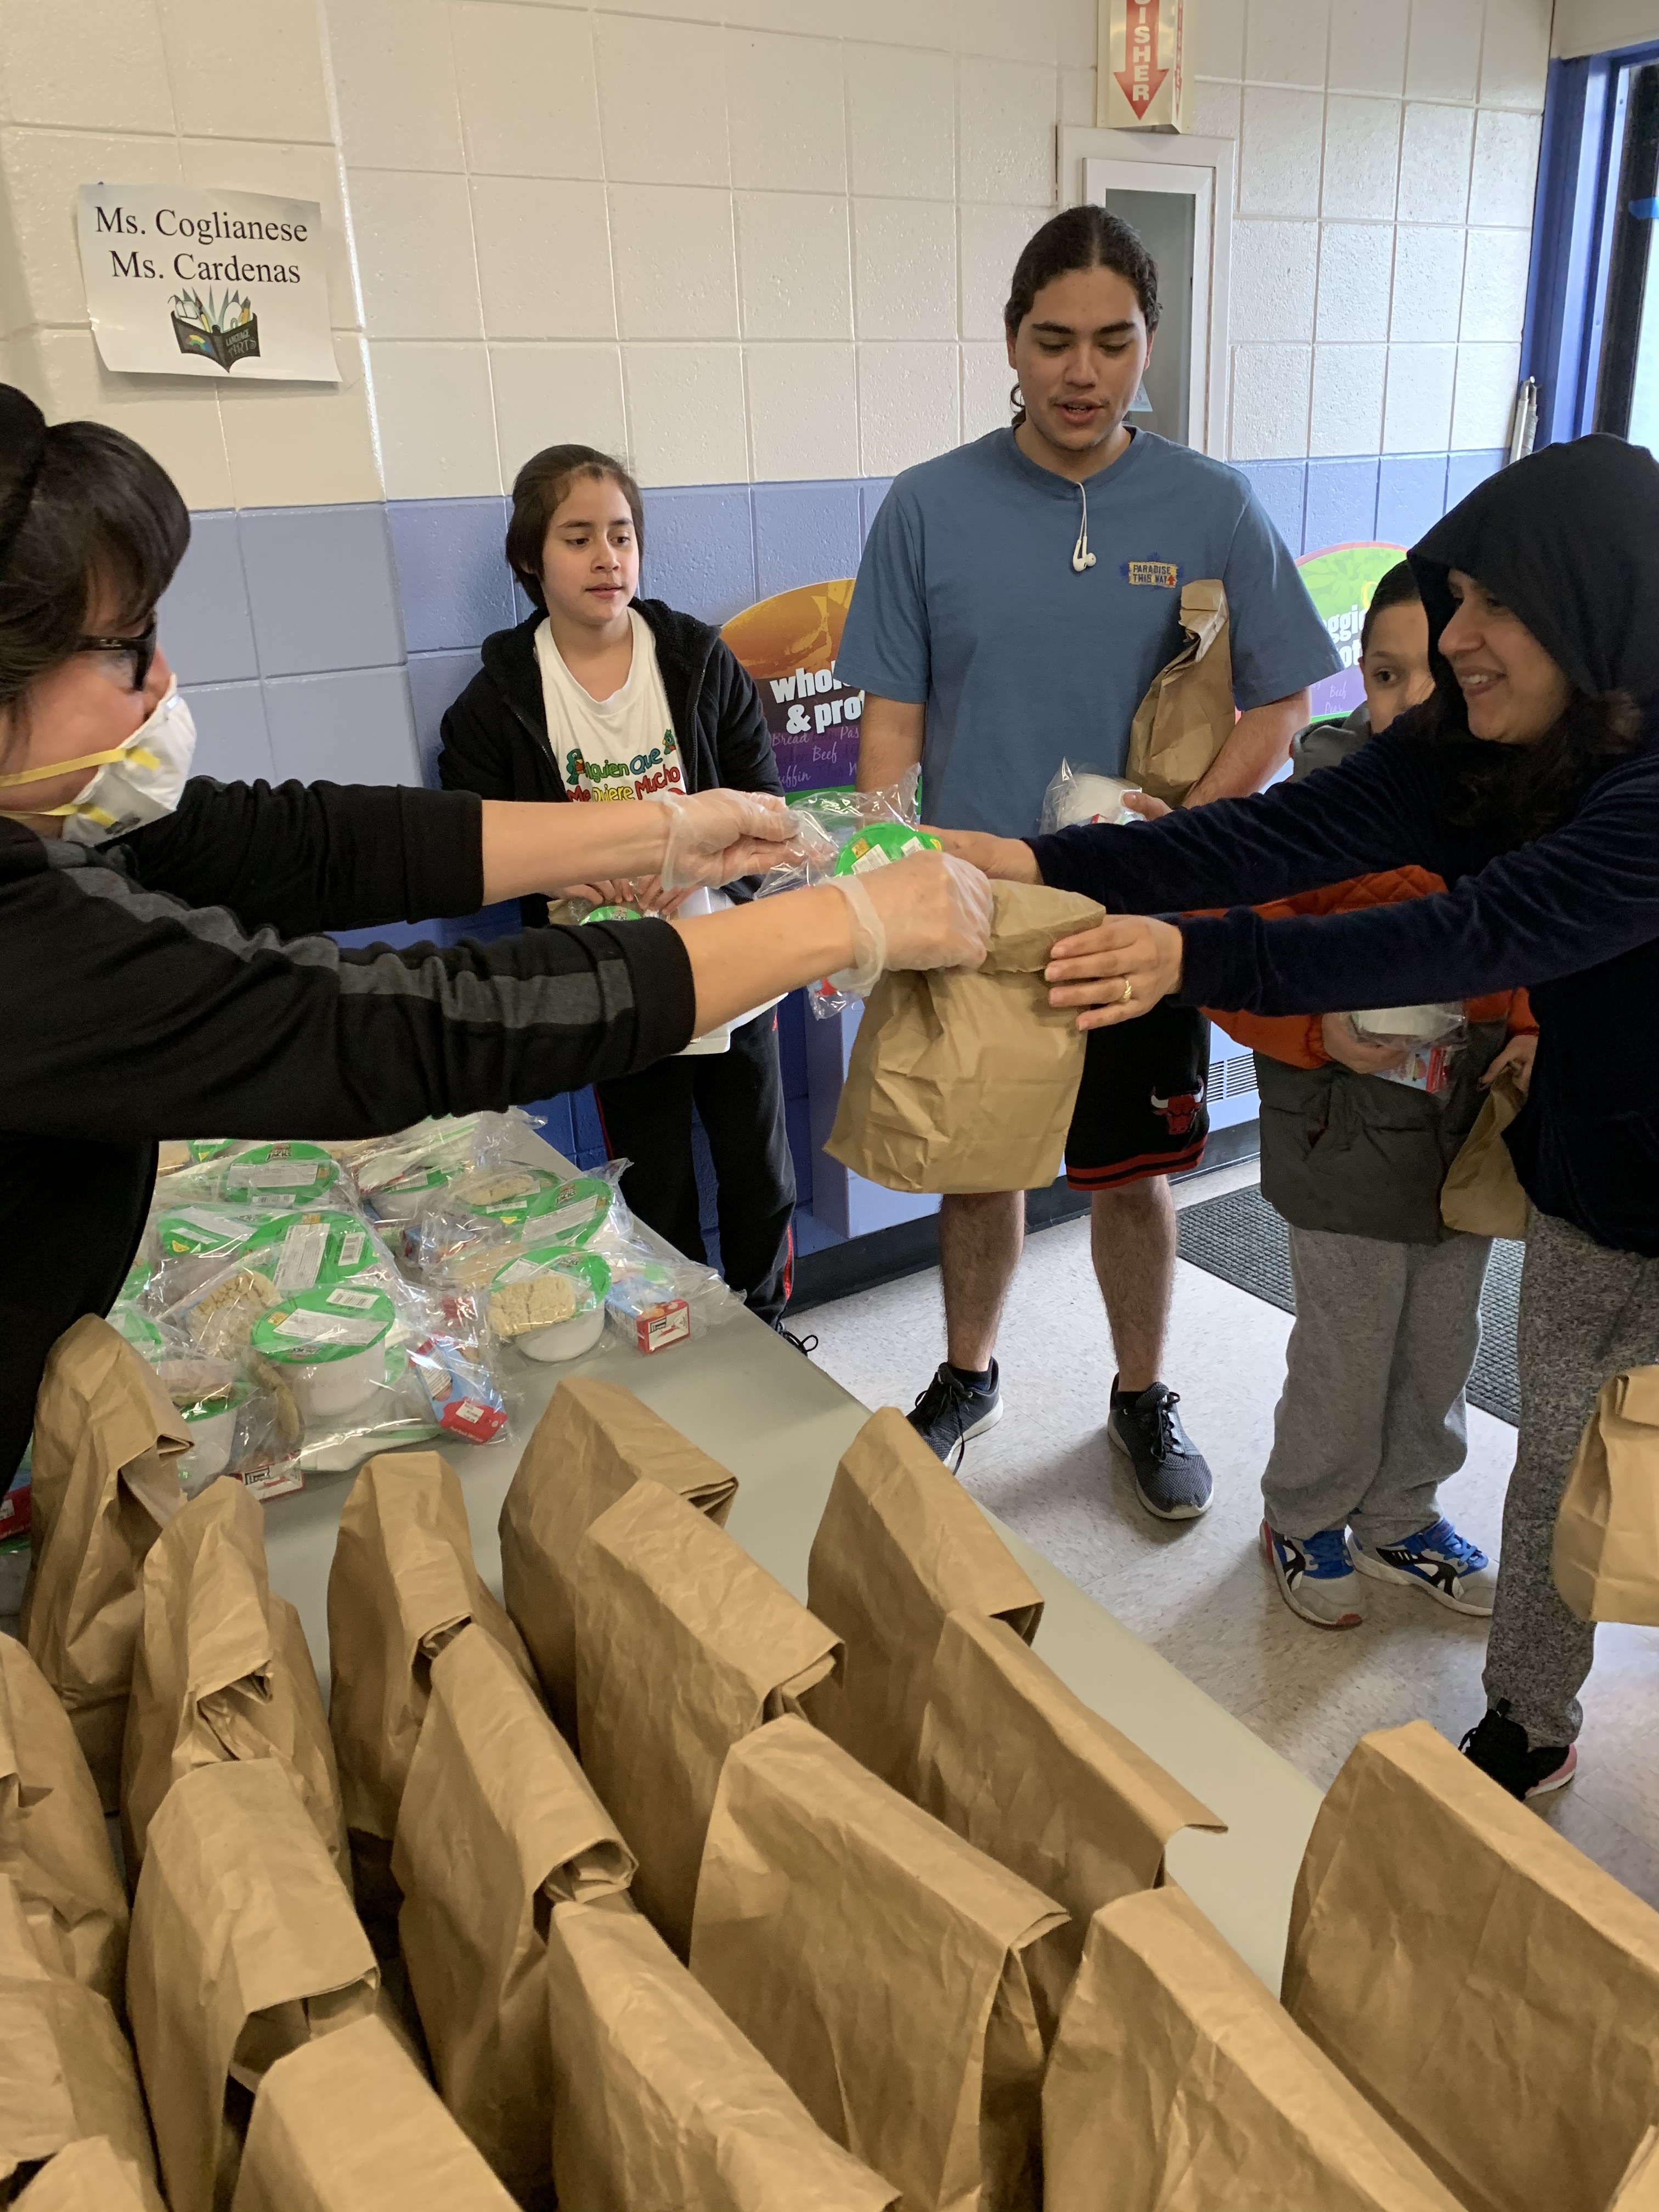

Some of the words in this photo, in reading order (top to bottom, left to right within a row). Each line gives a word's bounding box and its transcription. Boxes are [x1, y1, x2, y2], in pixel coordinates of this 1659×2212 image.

[94, 206, 146, 235] Ms.
[155, 208, 308, 245] Coglianese
[108, 250, 163, 279] Ms.
[173, 253, 301, 284] Cardenas
[225, 329, 250, 347] LANGUAGE
[228, 337, 257, 357] ARTS
[1133, 565, 1171, 574] PARADISE
[1133, 574, 1152, 583] THIS
[769, 660, 851, 704] whol
[1330, 681, 1347, 699] Beef
[786, 704, 811, 734] &
[772, 732, 810, 747] Bread
[840, 725, 860, 740] Pas
[630, 748, 663, 775] Que
[812, 741, 837, 763] Beef
[778, 764, 811, 787] uffin
[566, 785, 591, 802] Me
